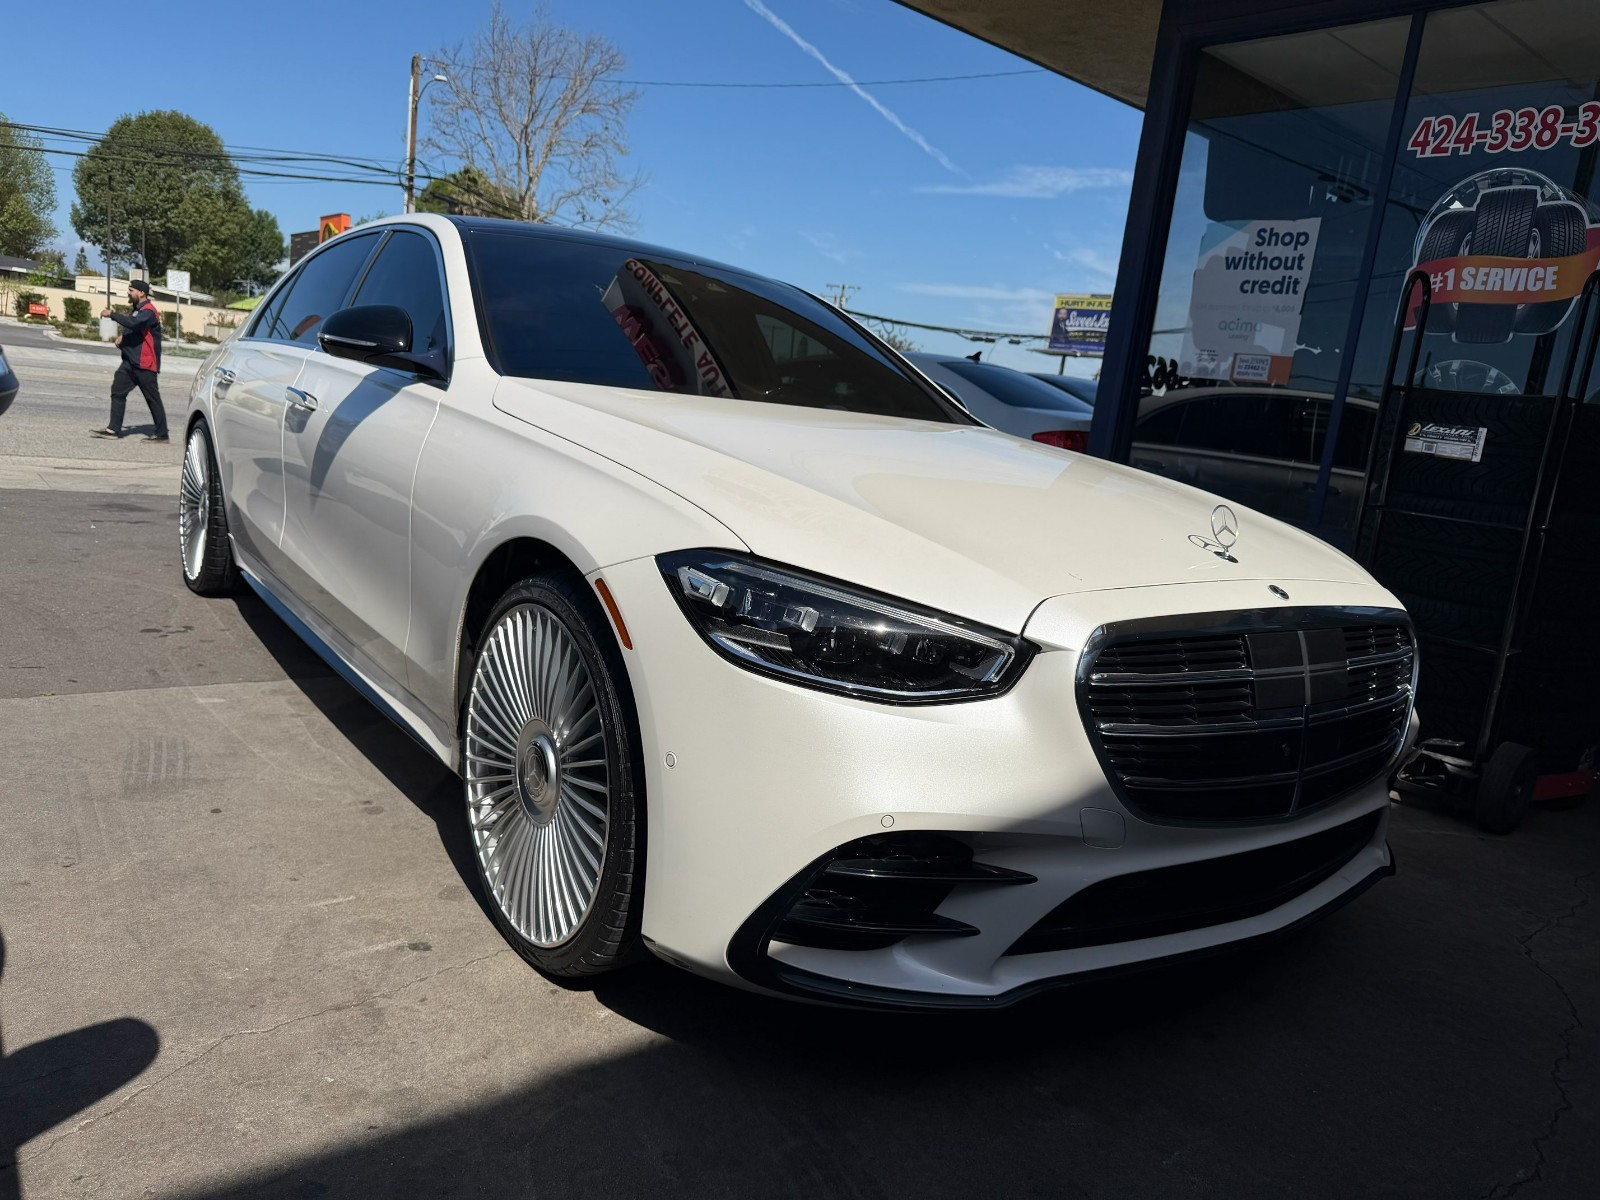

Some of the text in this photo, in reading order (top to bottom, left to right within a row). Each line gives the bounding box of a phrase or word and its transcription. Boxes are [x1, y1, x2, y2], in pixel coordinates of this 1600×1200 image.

[1407, 101, 1600, 158] 424-338-3
[1255, 227, 1309, 252] Shop
[1225, 251, 1305, 271] without
[1239, 275, 1301, 295] credit
[1430, 265, 1559, 292] #1 SERVICE
[1061, 300, 1085, 308] HURT
